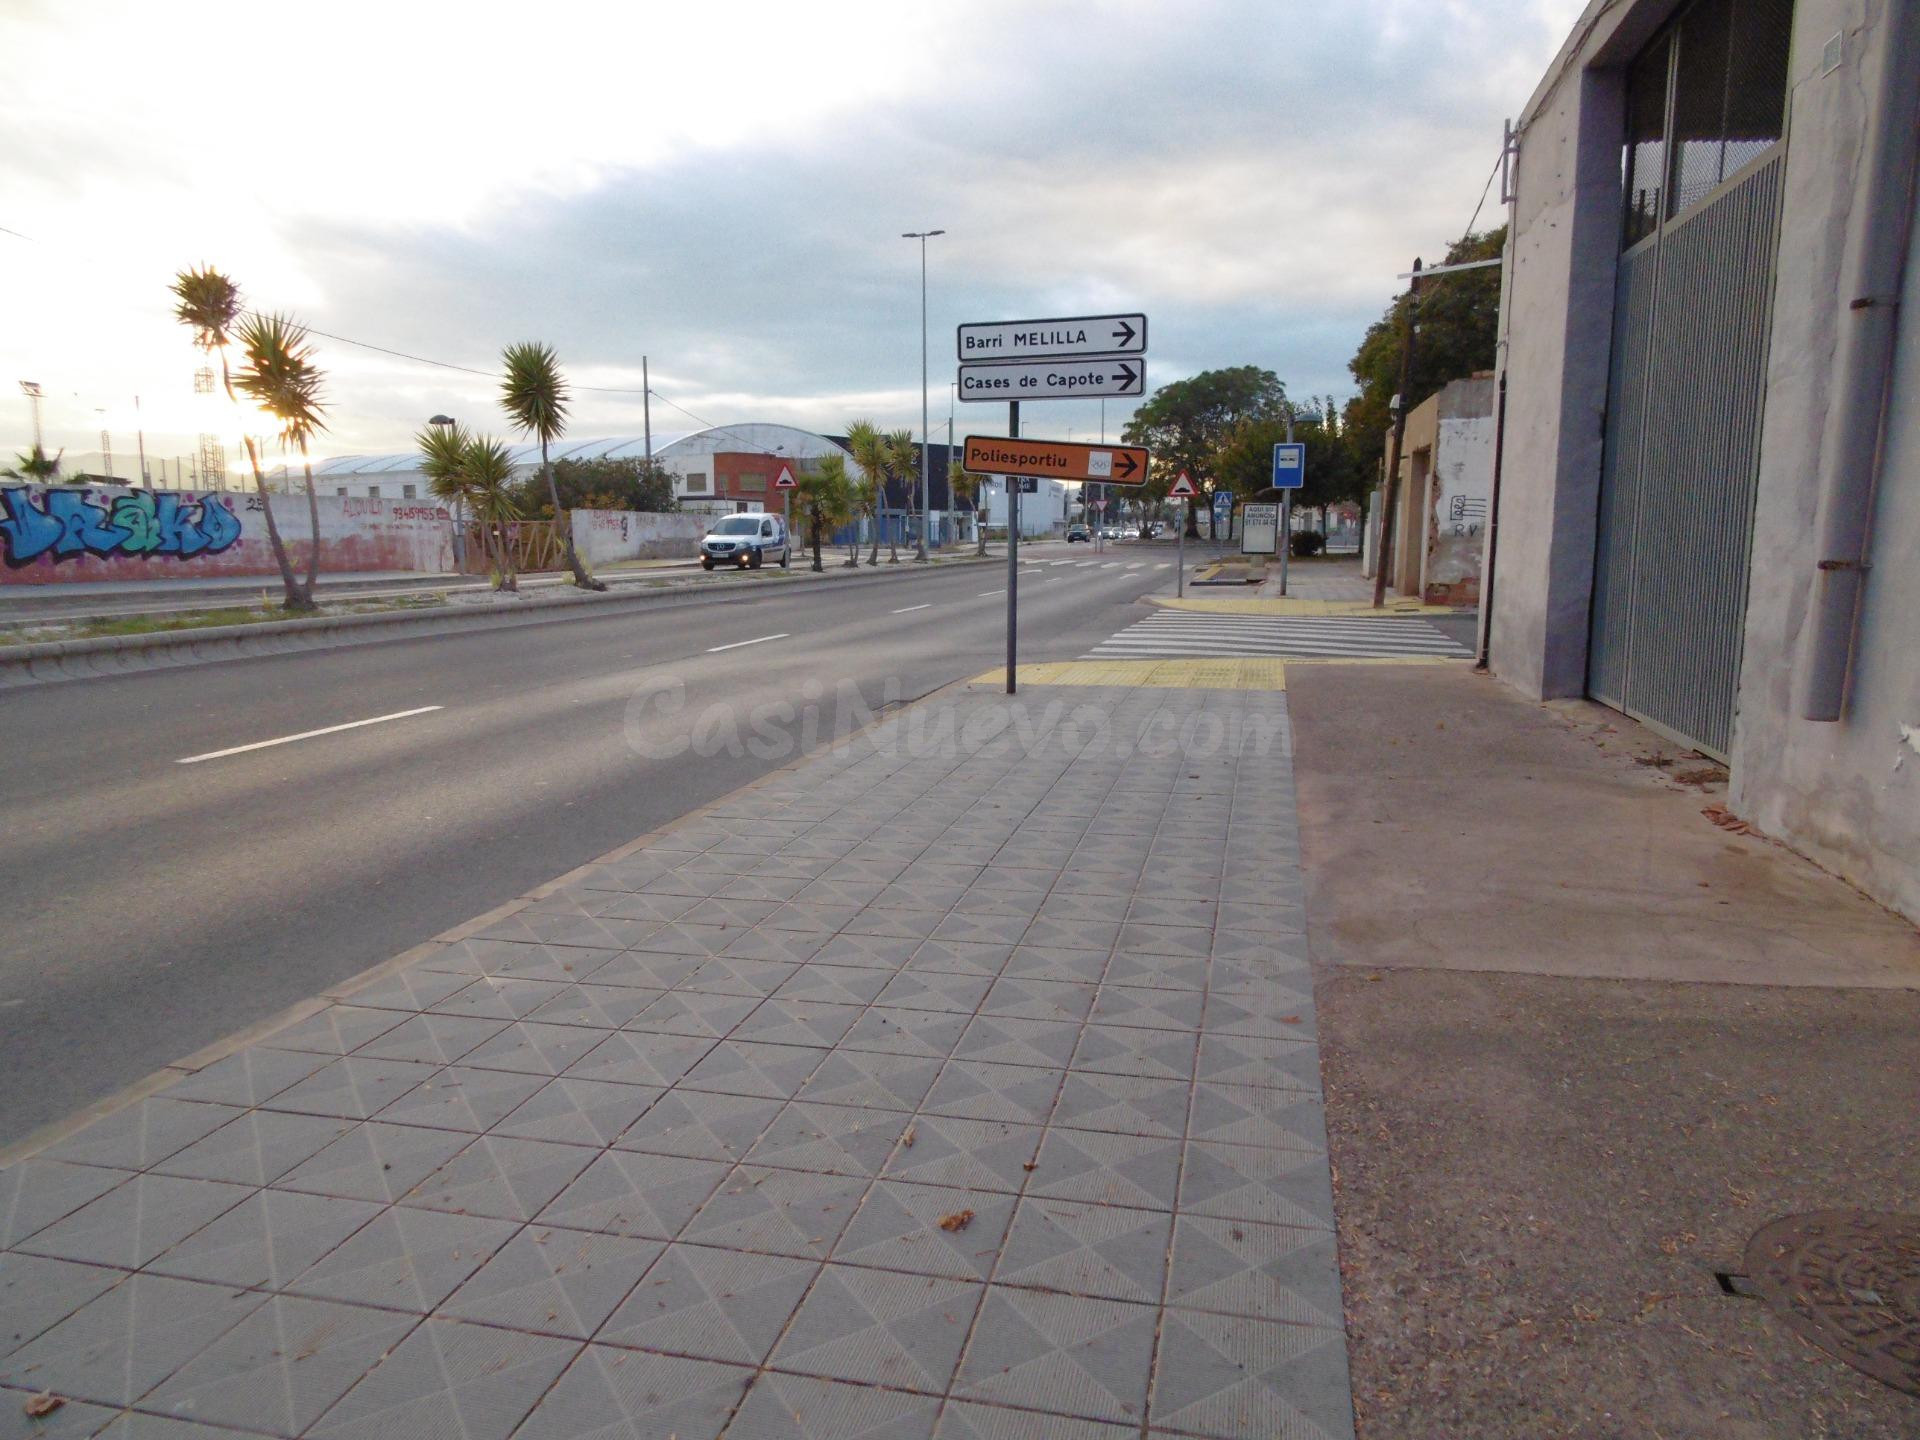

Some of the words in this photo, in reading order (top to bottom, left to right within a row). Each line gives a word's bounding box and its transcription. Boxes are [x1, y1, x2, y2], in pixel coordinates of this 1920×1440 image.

[966, 333, 1002, 349] Barri
[1014, 330, 1087, 346] MELILLA
[964, 376, 1010, 389] Cases
[1019, 375, 1038, 387] de
[1046, 372, 1104, 389] Capote
[971, 448, 1067, 468] Poliesportiu
